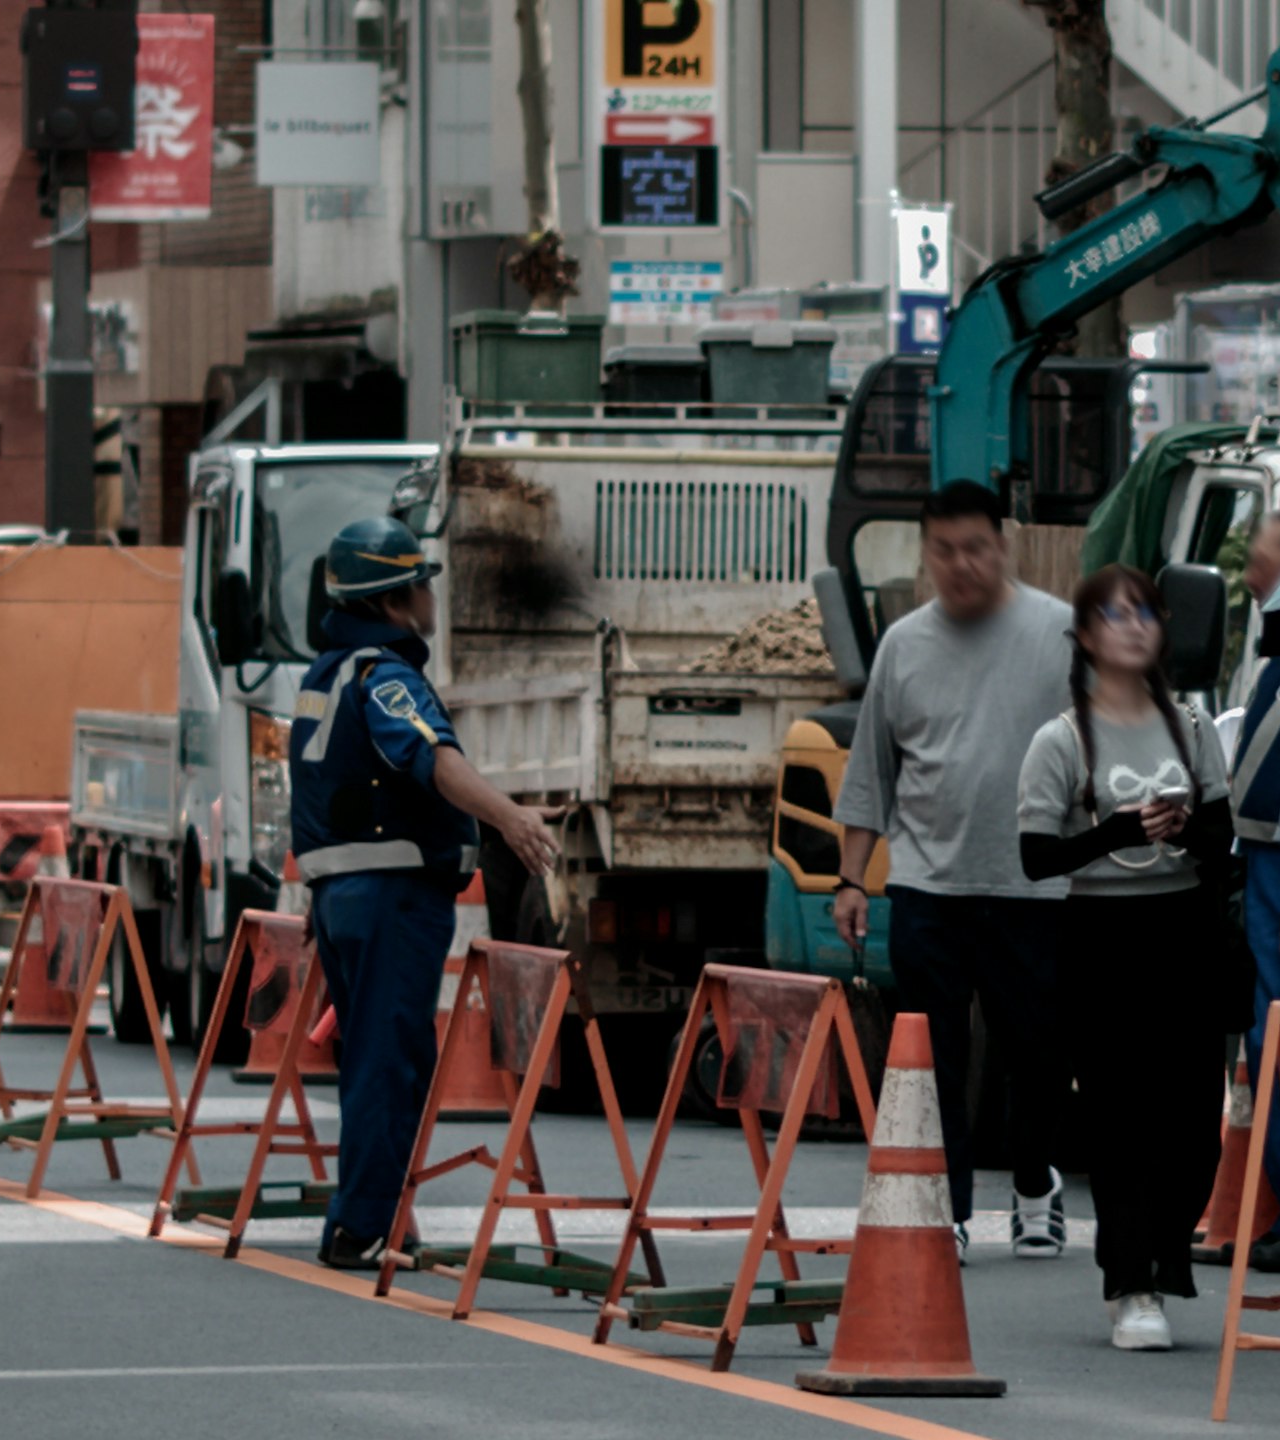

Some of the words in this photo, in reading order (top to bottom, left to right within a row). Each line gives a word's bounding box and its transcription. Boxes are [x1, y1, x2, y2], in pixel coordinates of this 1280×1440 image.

[622, 0, 701, 76] P
[648, 55, 701, 77] 24H
[622, 150, 696, 223] 空
